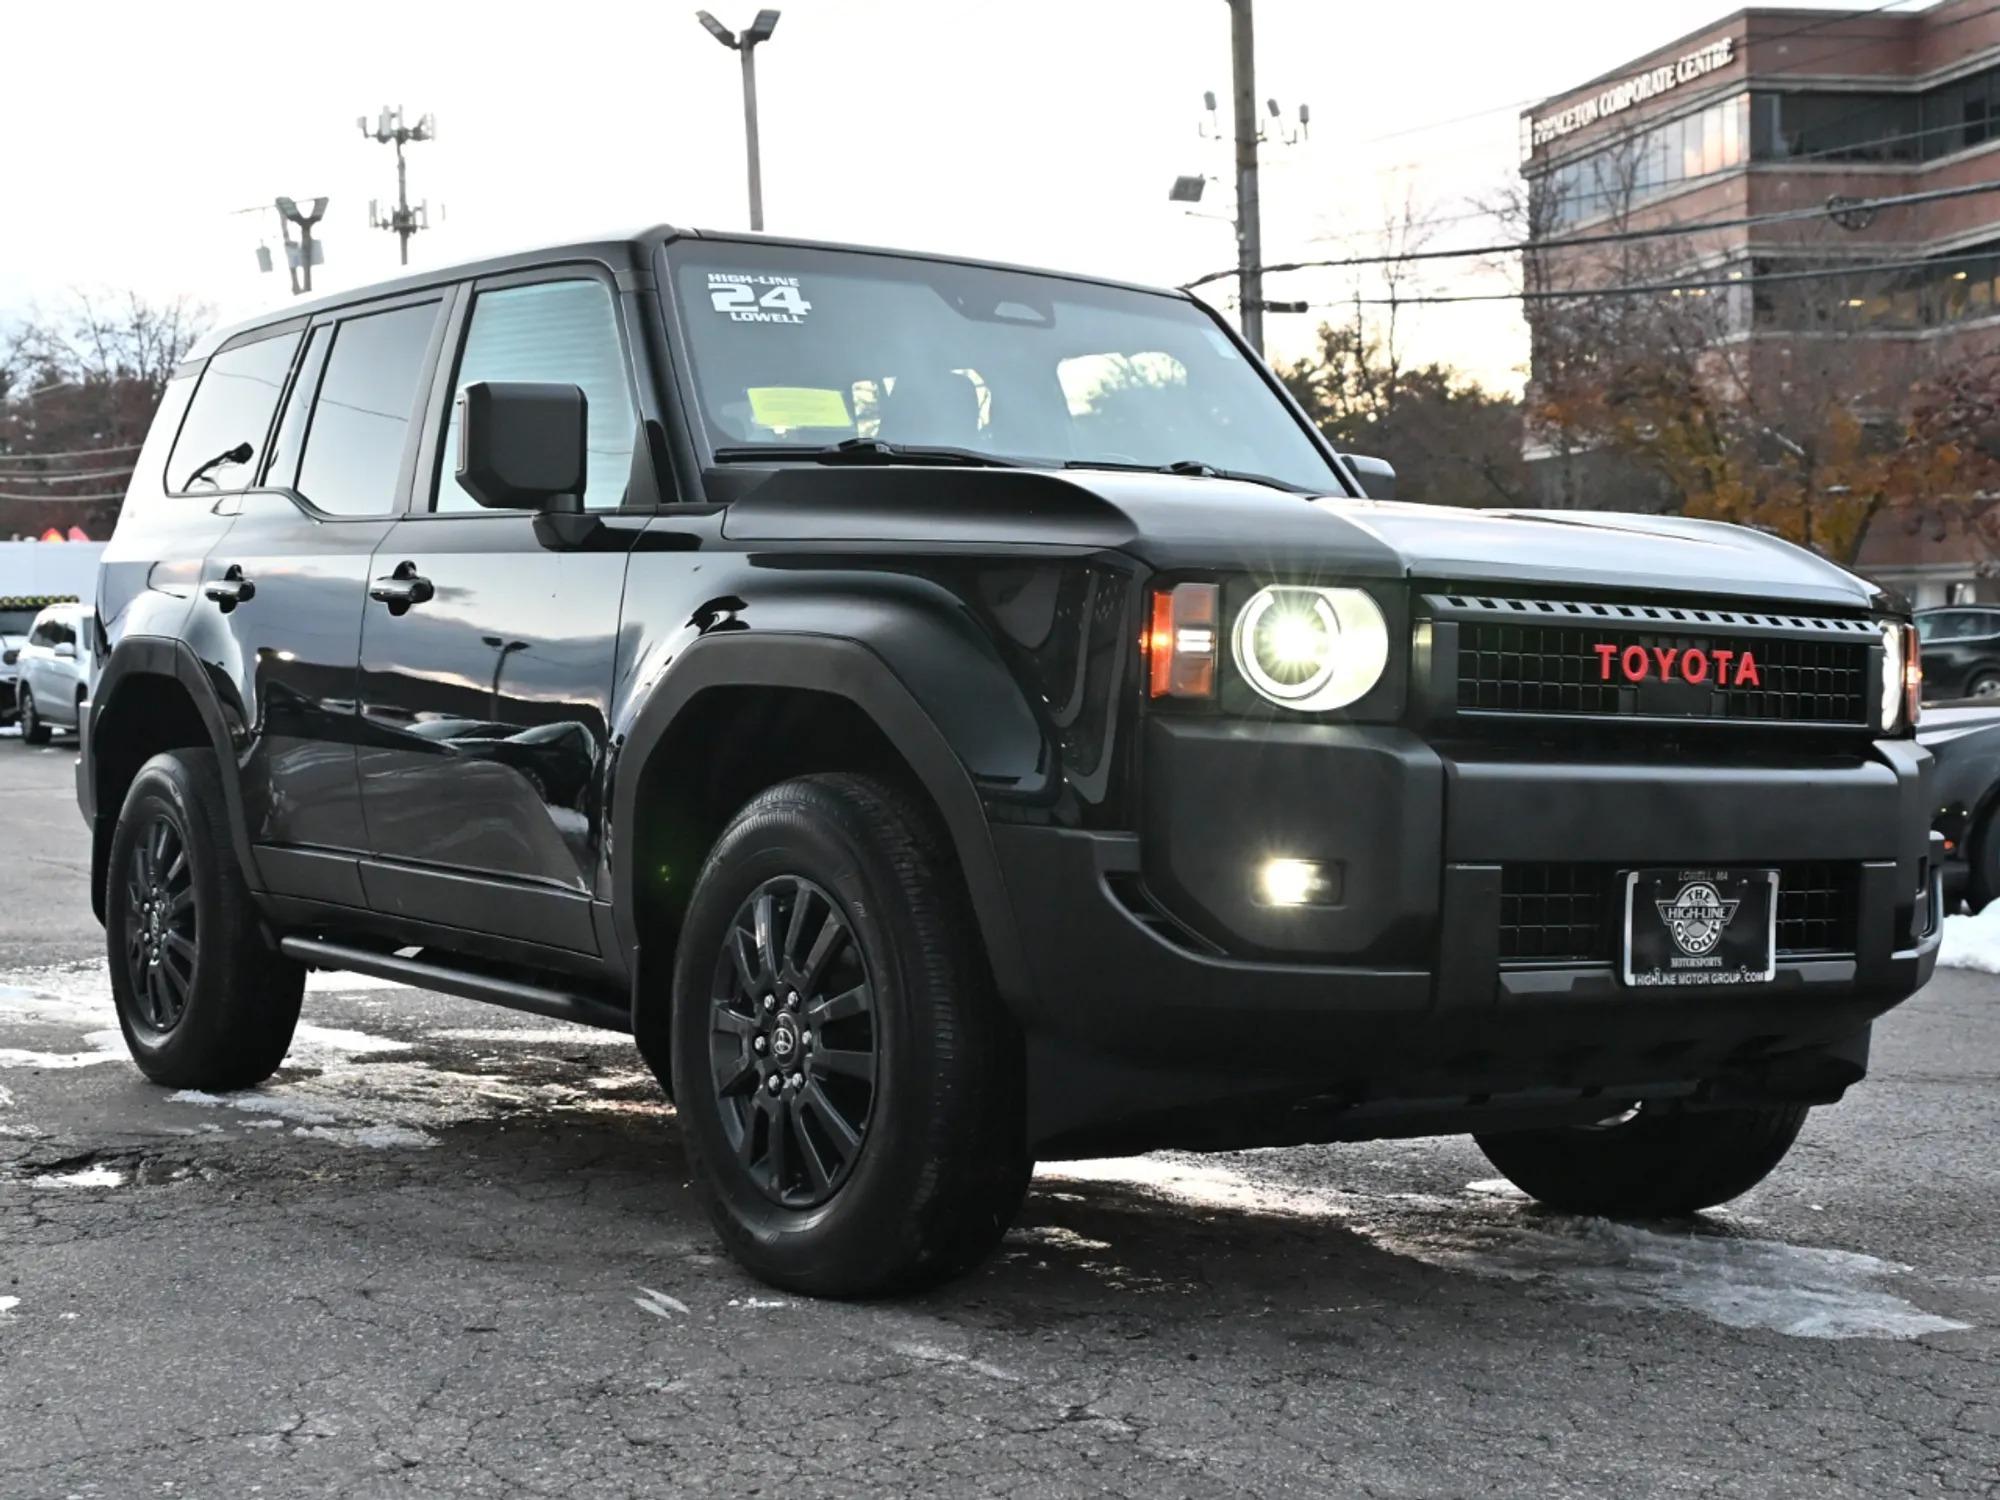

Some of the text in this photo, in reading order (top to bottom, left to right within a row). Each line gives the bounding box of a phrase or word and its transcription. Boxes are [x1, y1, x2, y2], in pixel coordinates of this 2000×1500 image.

[1533, 37, 1734, 146] PRINCETON CORPORATE CENTRE
[707, 273, 800, 287] HIGH-LINE
[707, 283, 812, 315] 24
[730, 312, 804, 323] LOWELL
[1594, 644, 1760, 685] TOYOTA
[1686, 889, 1711, 904] THE
[1668, 907, 1727, 919] HIGH-LINE
[1675, 920, 1719, 951] GROUP
[1670, 957, 1722, 968] MOTORSPORTS
[1678, 974, 1710, 985] MOTOR
